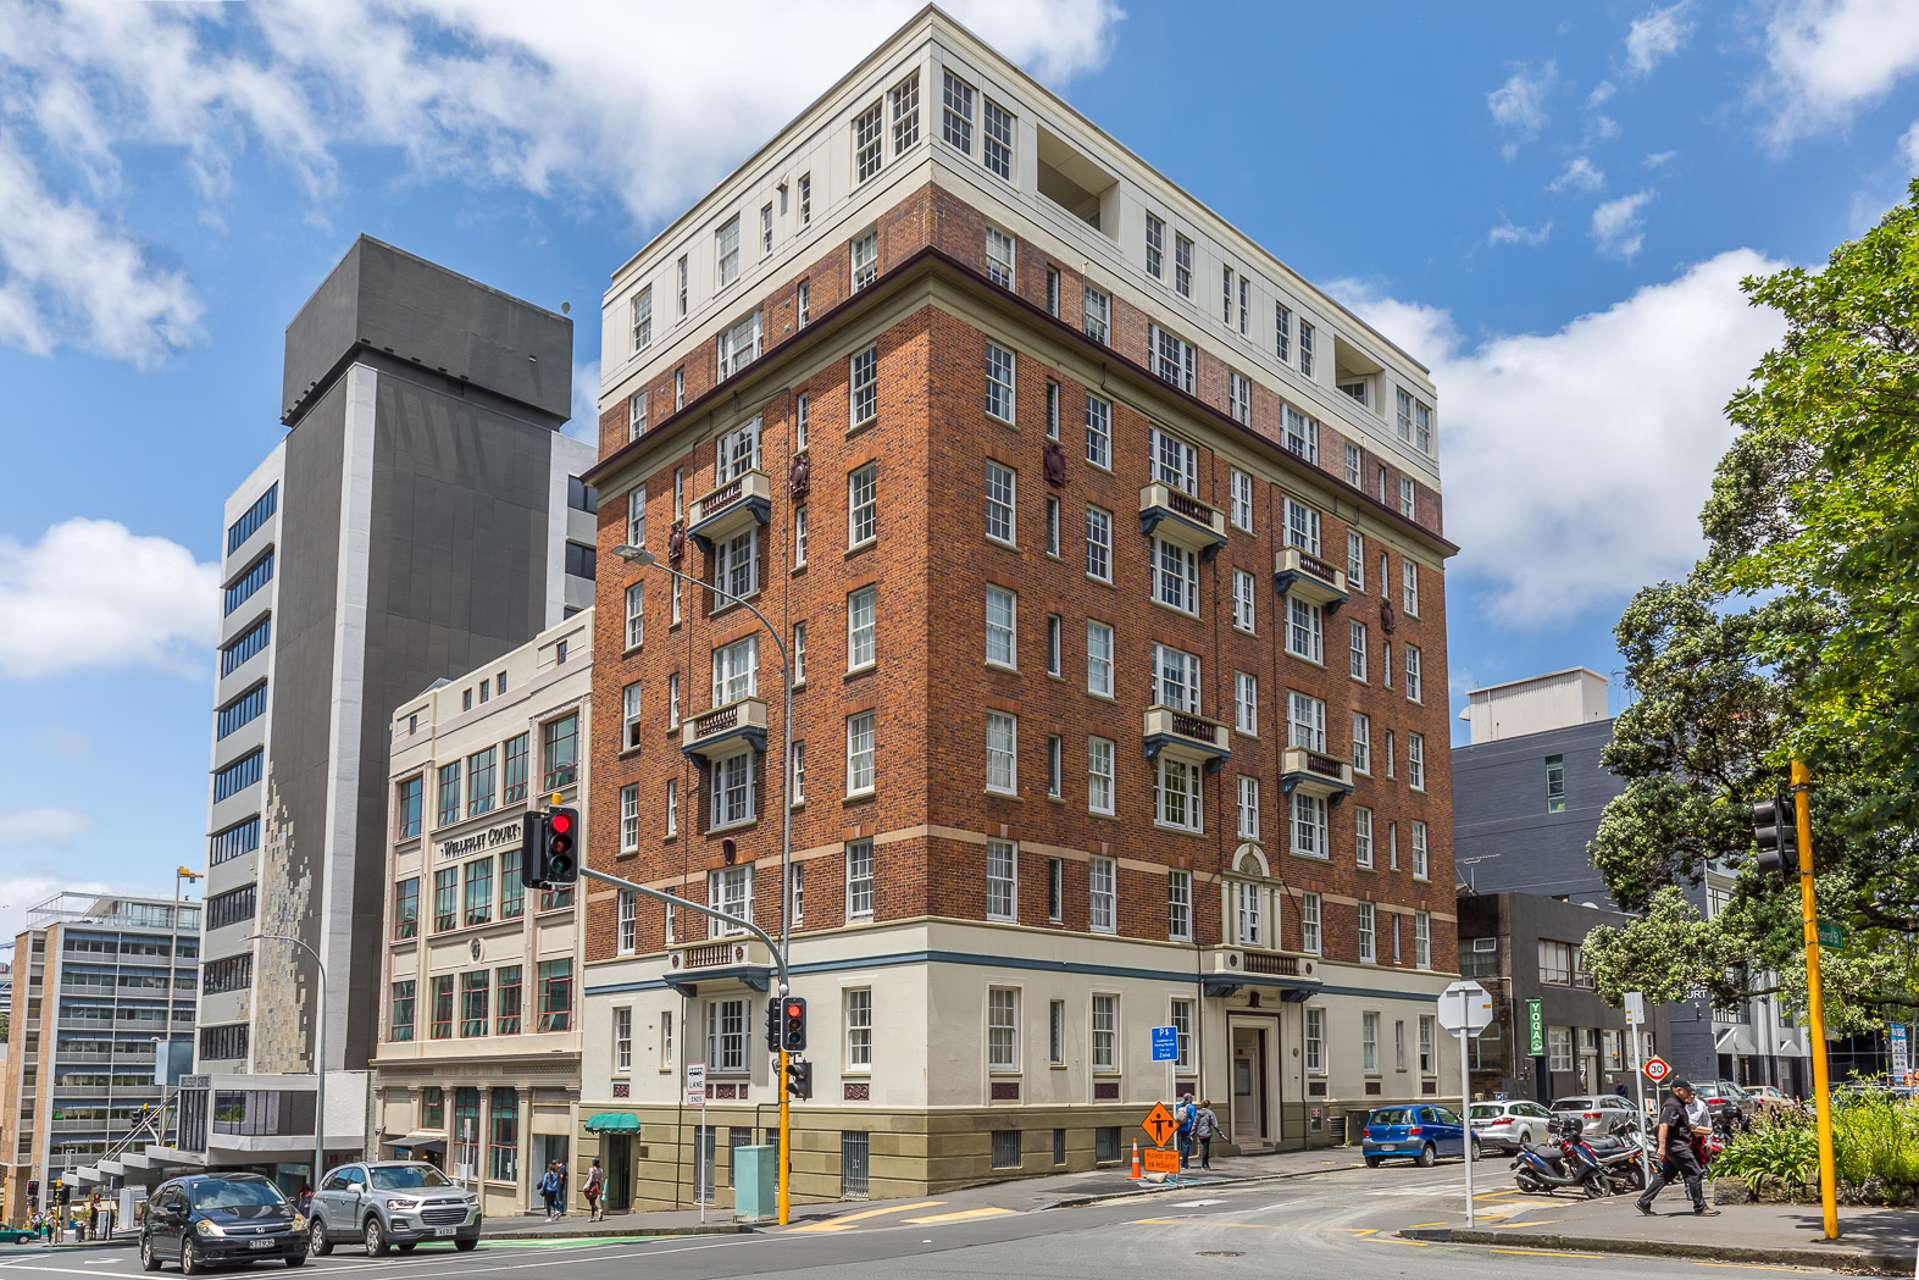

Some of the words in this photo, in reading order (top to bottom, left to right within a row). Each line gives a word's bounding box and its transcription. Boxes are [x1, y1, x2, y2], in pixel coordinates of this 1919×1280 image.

[444, 832, 486, 857] WELLESLEY
[488, 823, 518, 846] COURT
[1686, 989, 1706, 999] URT
[1532, 1003, 1541, 1040] YOGA
[1651, 1065, 1663, 1074] 30
[689, 1080, 703, 1089] LANE
